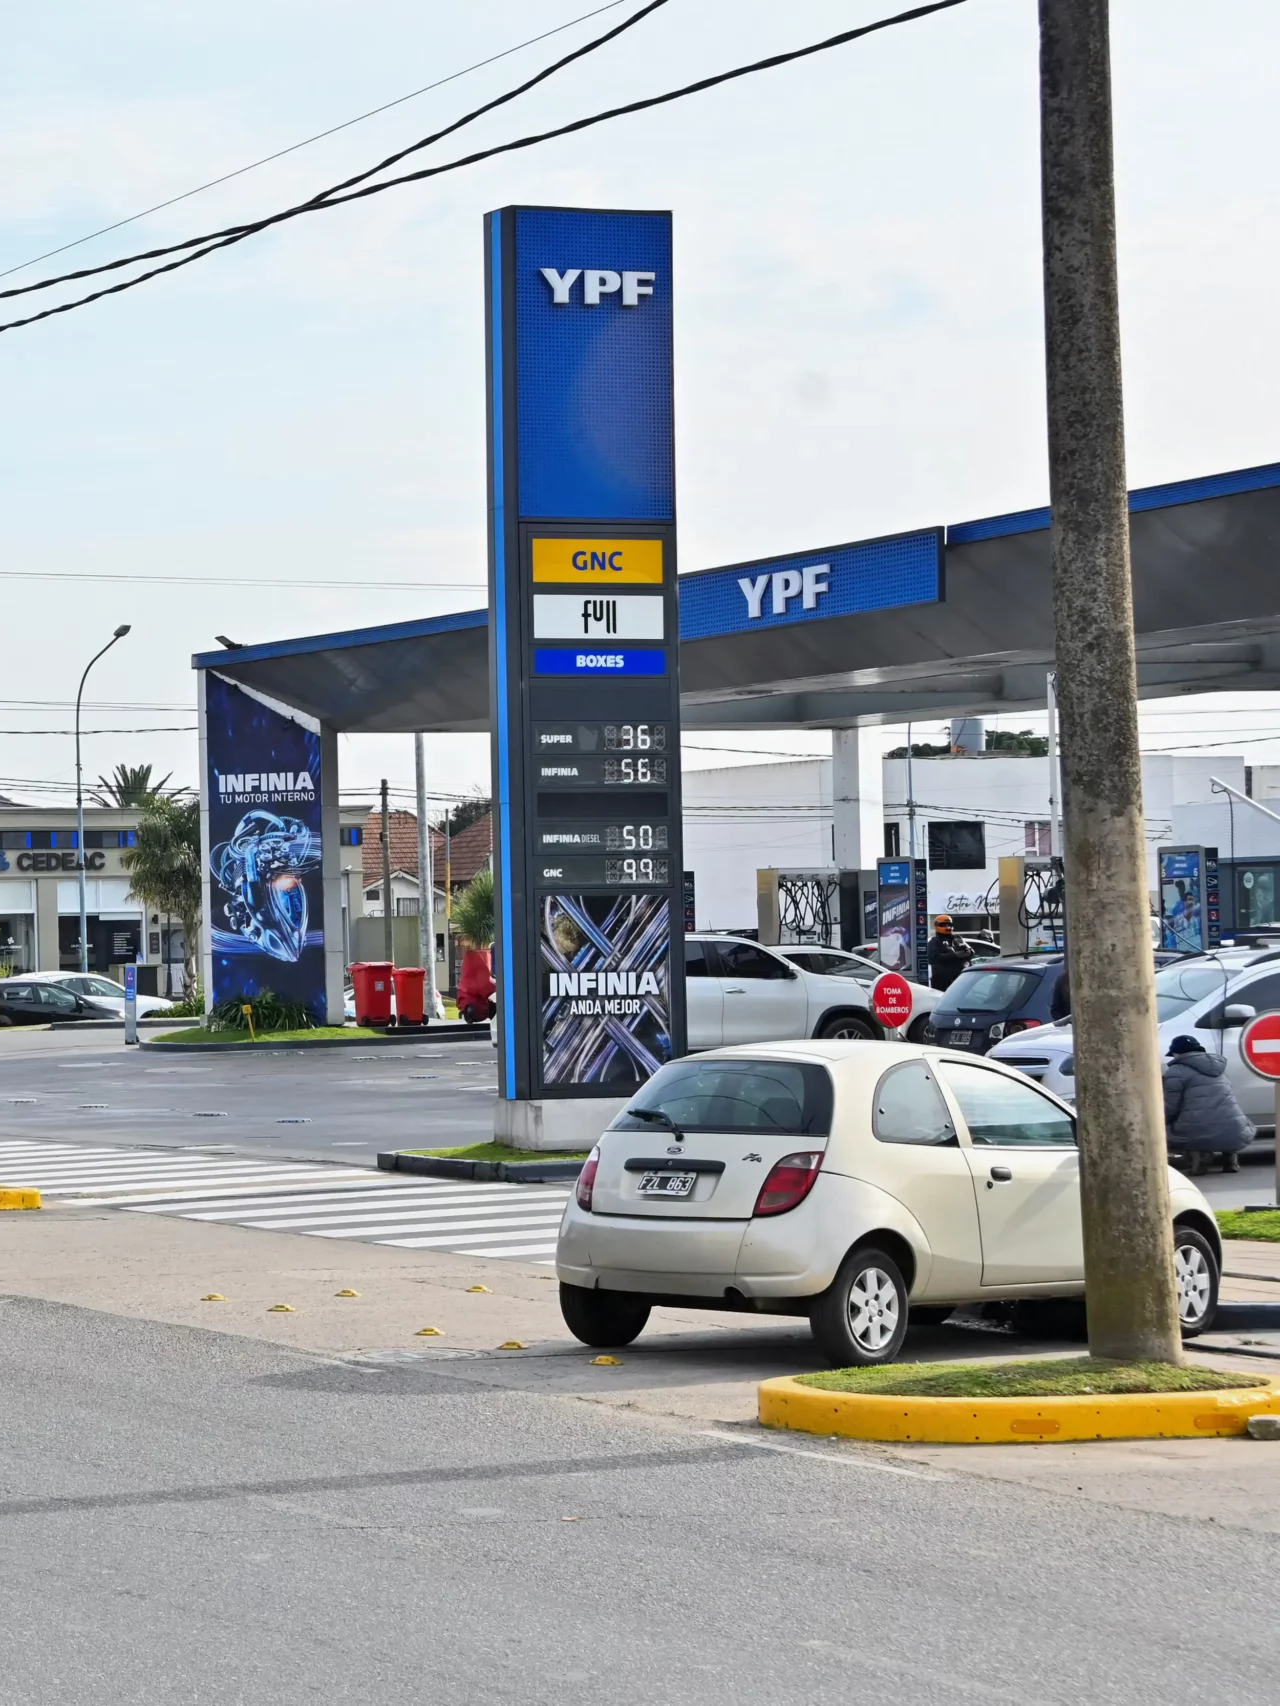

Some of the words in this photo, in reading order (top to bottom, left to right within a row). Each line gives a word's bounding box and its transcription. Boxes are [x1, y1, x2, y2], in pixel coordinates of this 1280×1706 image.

[540, 268, 655, 305] YPF
[572, 551, 623, 571] GNC
[737, 564, 830, 618] YPF
[581, 600, 617, 634] full
[576, 655, 624, 668] BOXES
[540, 734, 573, 744] SUPER
[541, 767, 579, 776] INFINIA
[218, 771, 315, 793] INFINIA
[219, 794, 232, 804] TU
[235, 793, 269, 803] MOTOR
[271, 791, 315, 802] INTERNO
[542, 834, 581, 843] INFINIA
[581, 834, 601, 843] DIESEL
[543, 868, 563, 878] GNC
[1193, 868, 1198, 877] 6
[882, 900, 910, 926] INFINIA
[549, 971, 660, 997] INFINIA
[883, 987, 902, 995] TOMA
[570, 999, 603, 1015] ANDA
[604, 999, 641, 1014] MEJOR
[876, 1006, 909, 1014] BOMBEROS
[639, 1176, 659, 1190] FZL
[667, 1177, 691, 1191] 863
